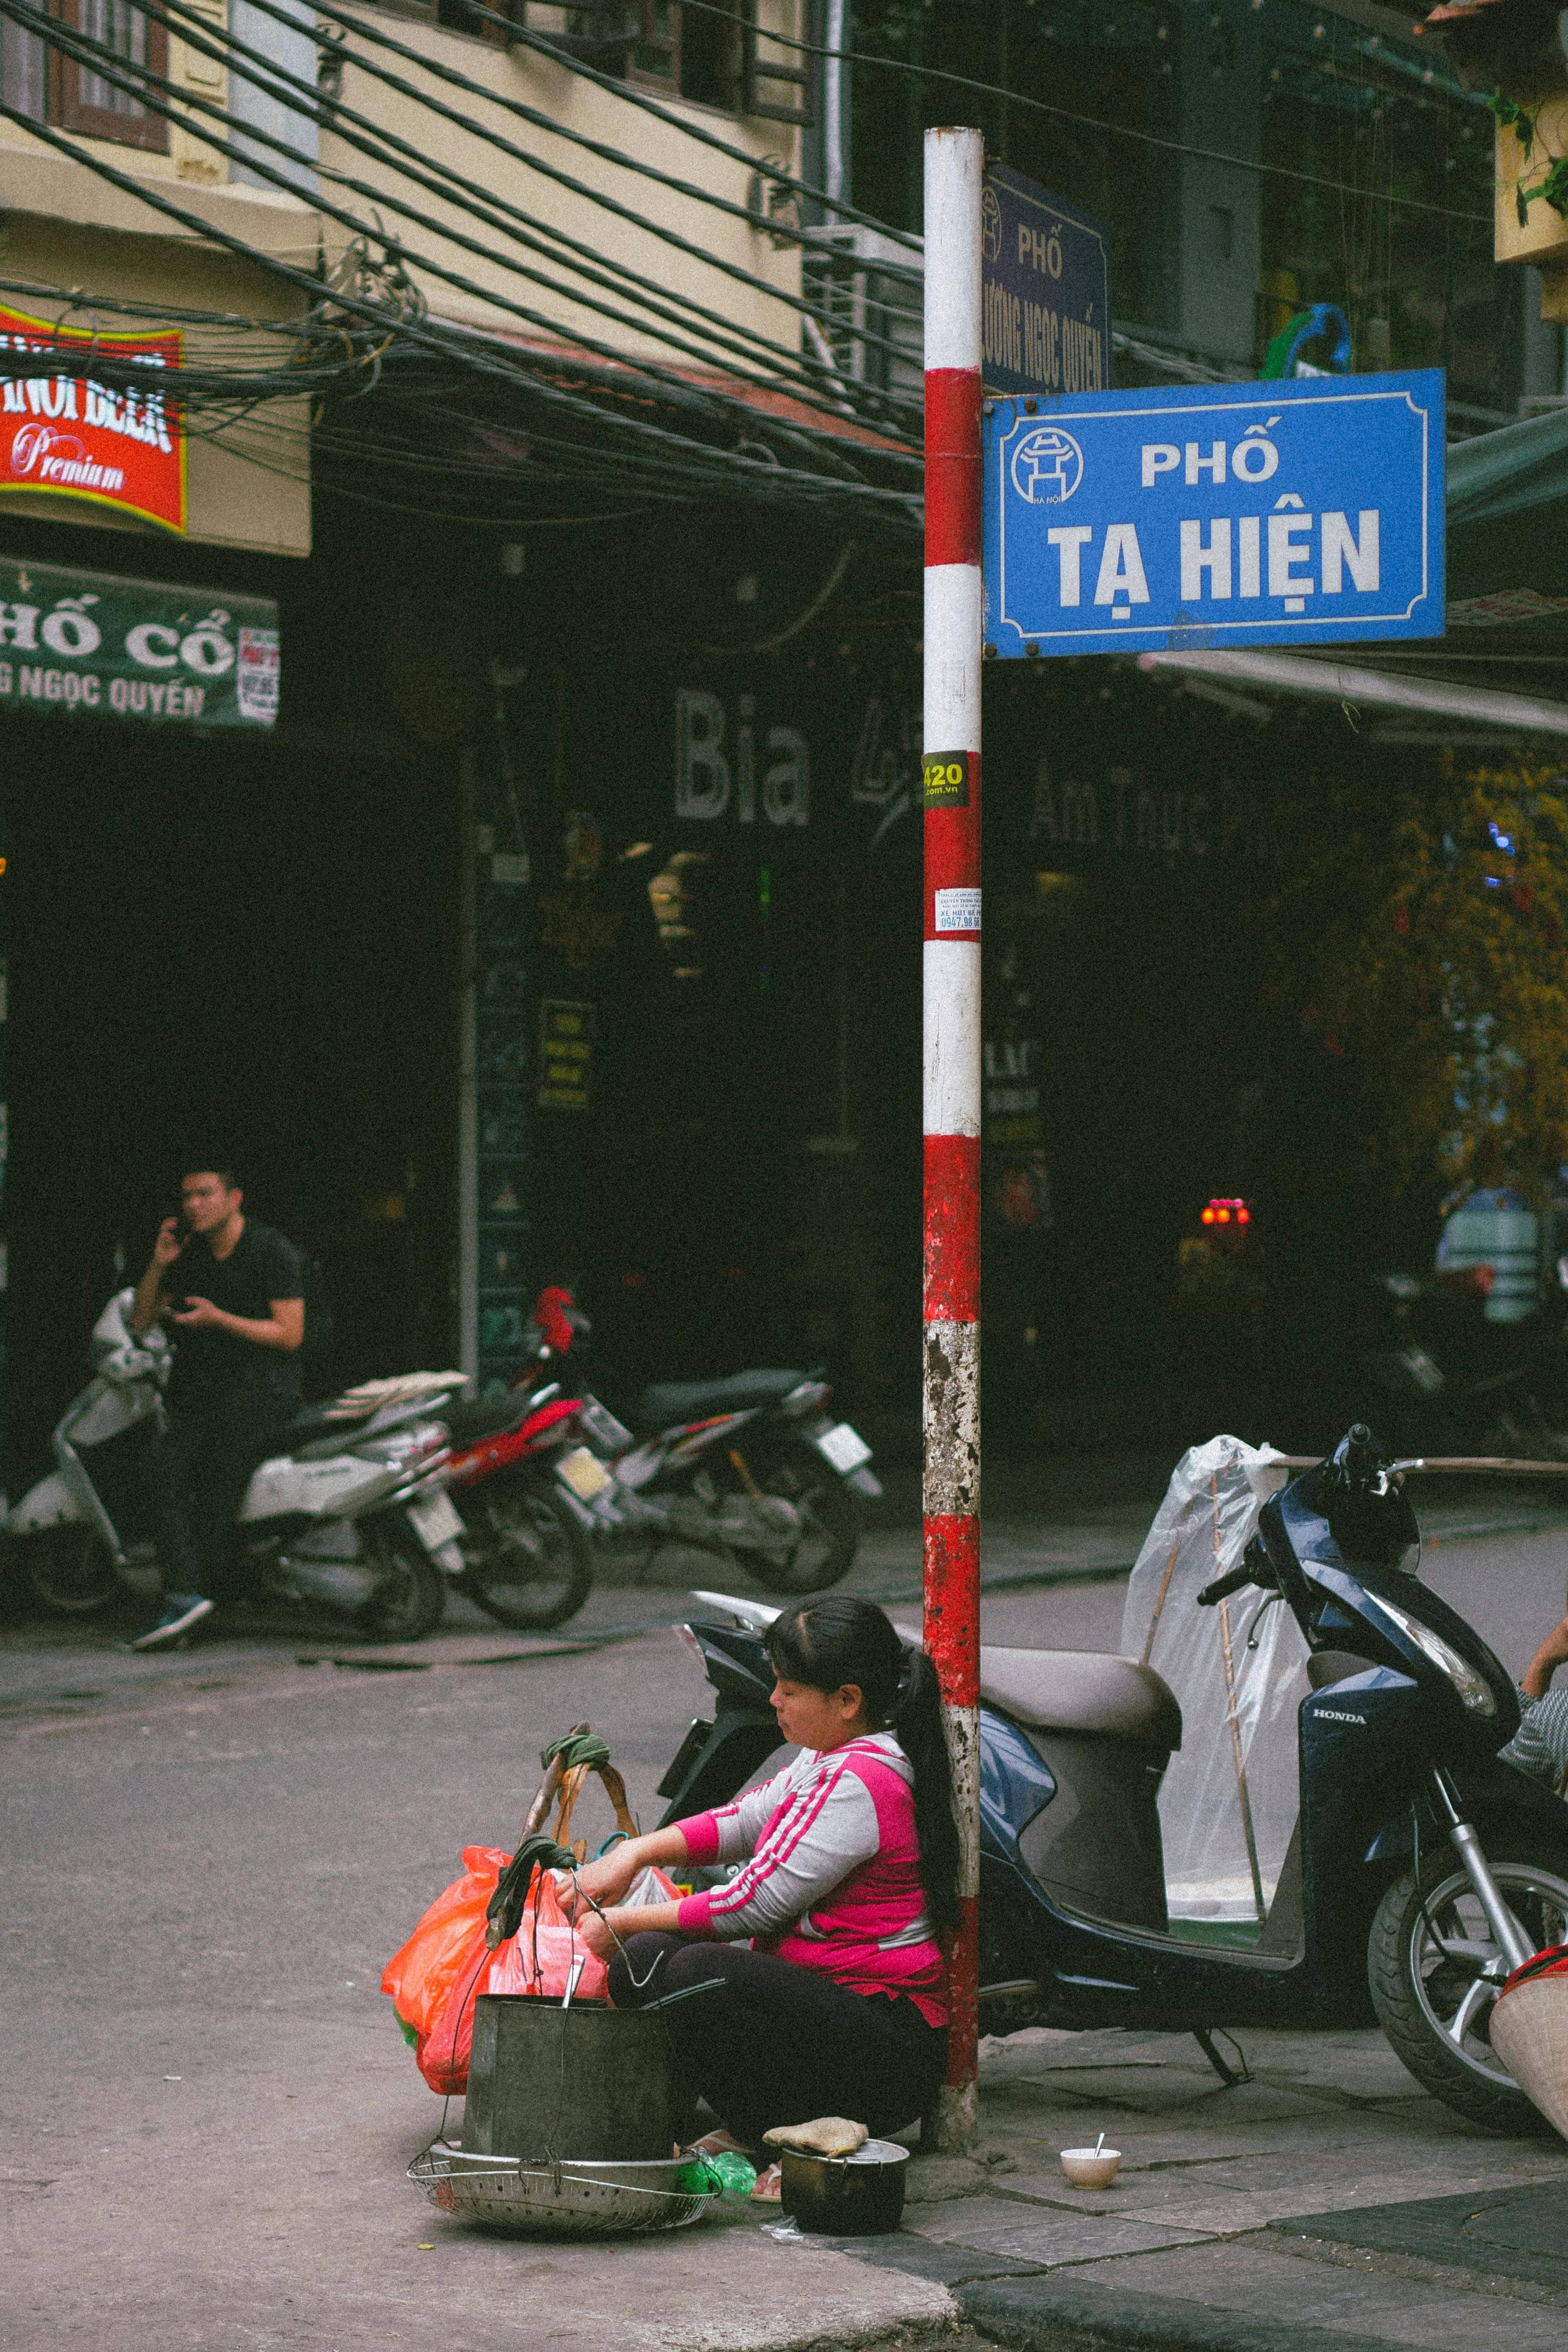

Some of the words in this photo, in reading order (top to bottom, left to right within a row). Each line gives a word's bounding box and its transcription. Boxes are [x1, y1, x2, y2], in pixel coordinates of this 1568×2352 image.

[1018, 223, 1063, 279] PHỐ
[981, 278, 1021, 374] ƯƠNG
[1024, 299, 1060, 395] NGỌC
[10, 422, 127, 492] Premium
[1141, 416, 1282, 488] PHỐ
[1046, 494, 1061, 505] NỘI
[1048, 523, 1151, 620] TẠ
[1180, 493, 1380, 612] HIỆN
[126, 609, 236, 676] CỔ
[20, 665, 101, 710] NGỌC
[110, 677, 205, 718] QUYẾN
[676, 688, 808, 826] Bia
[1313, 1709, 1367, 1725] HONDA
